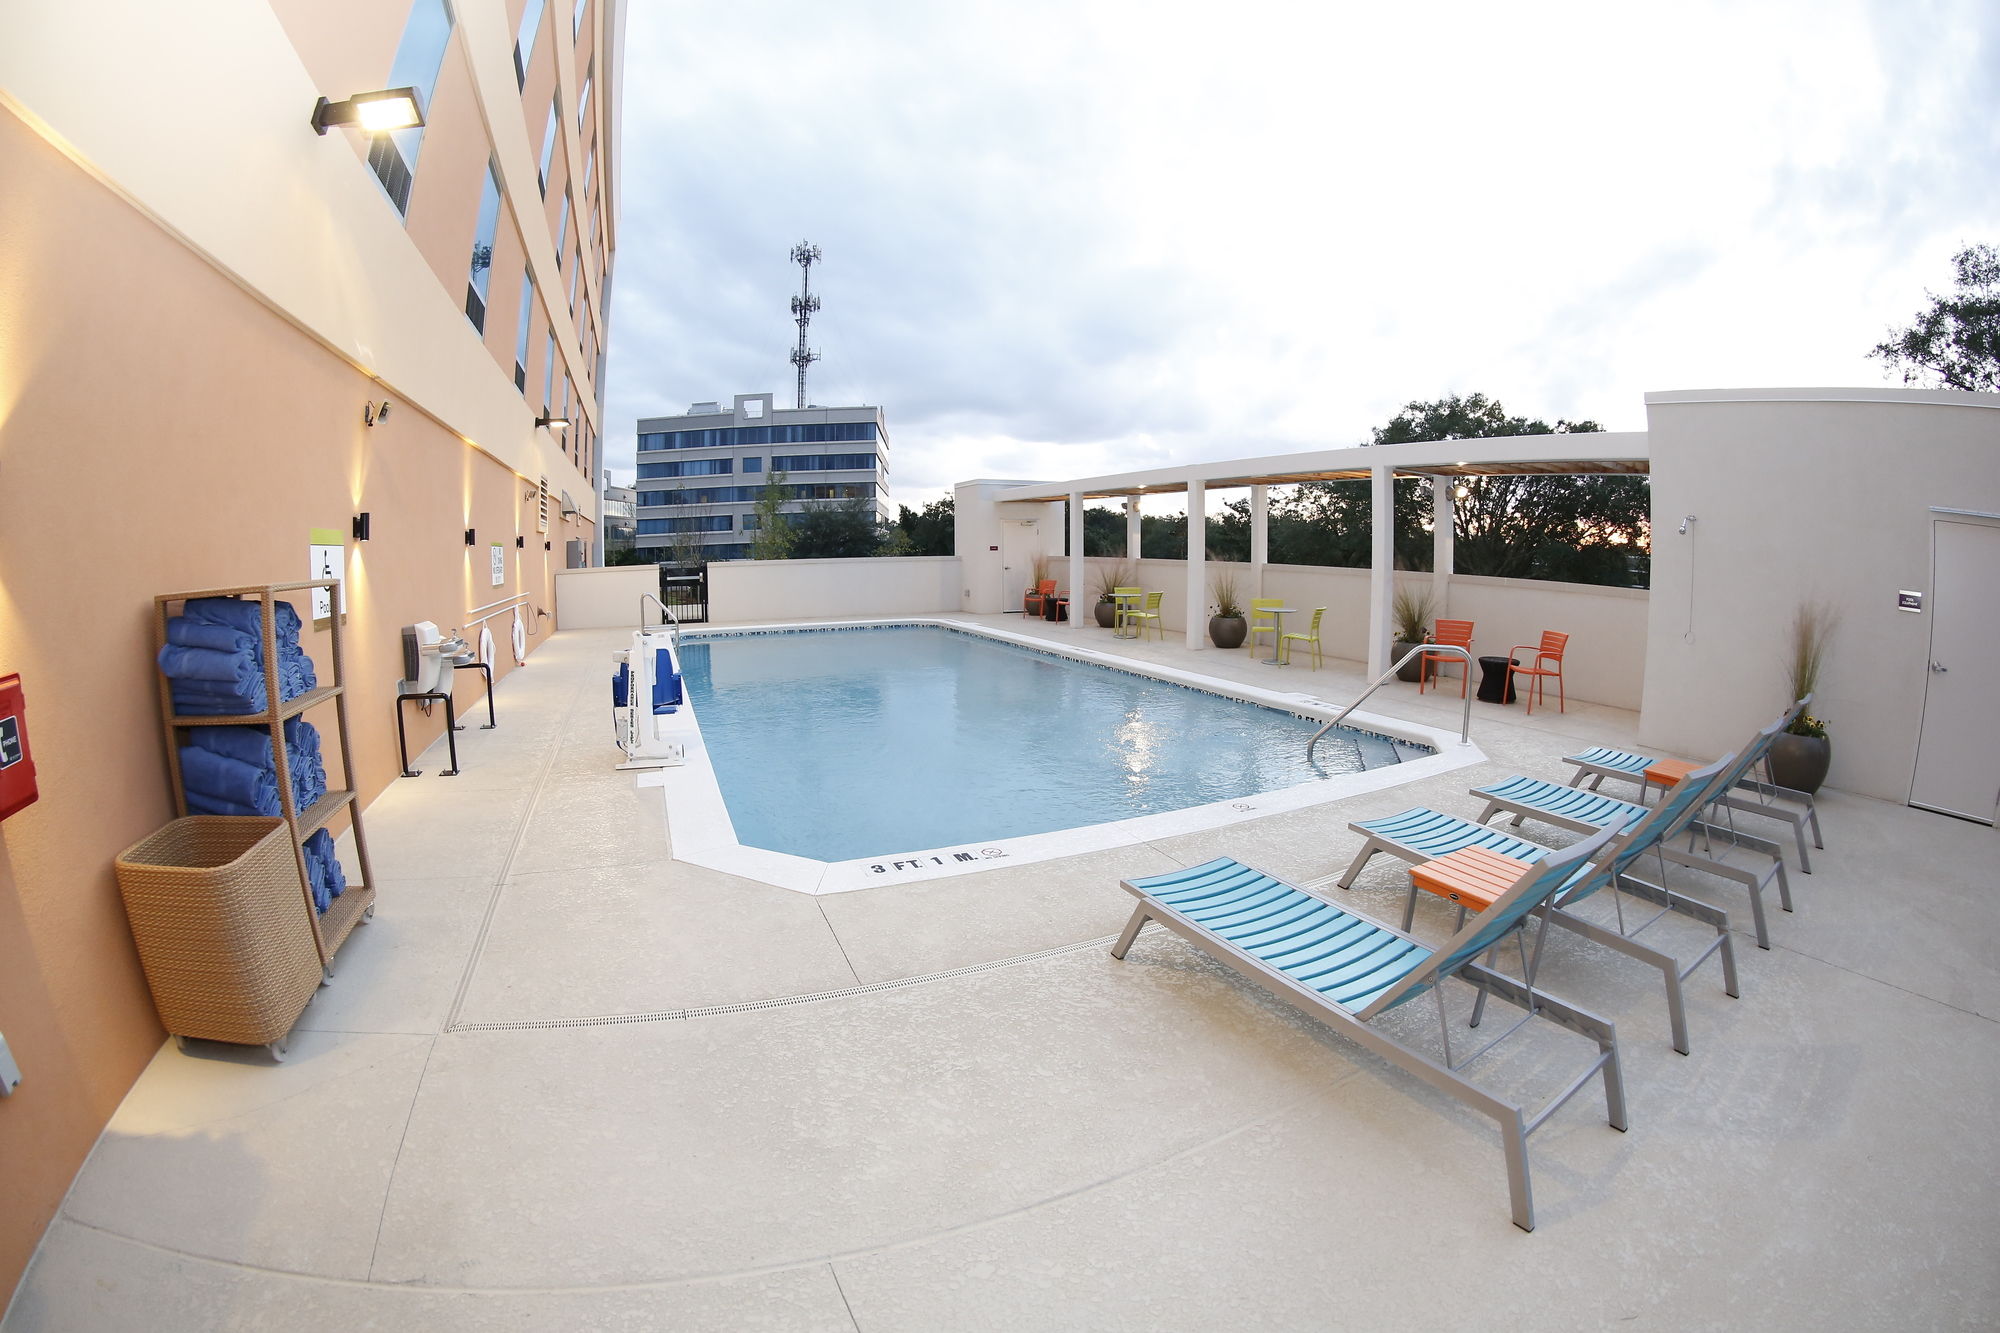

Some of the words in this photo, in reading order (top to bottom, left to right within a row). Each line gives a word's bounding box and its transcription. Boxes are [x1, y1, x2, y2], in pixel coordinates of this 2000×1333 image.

[320, 600, 332, 614] Poo
[870, 864, 887, 874] 3
[930, 856, 944, 865] 1
